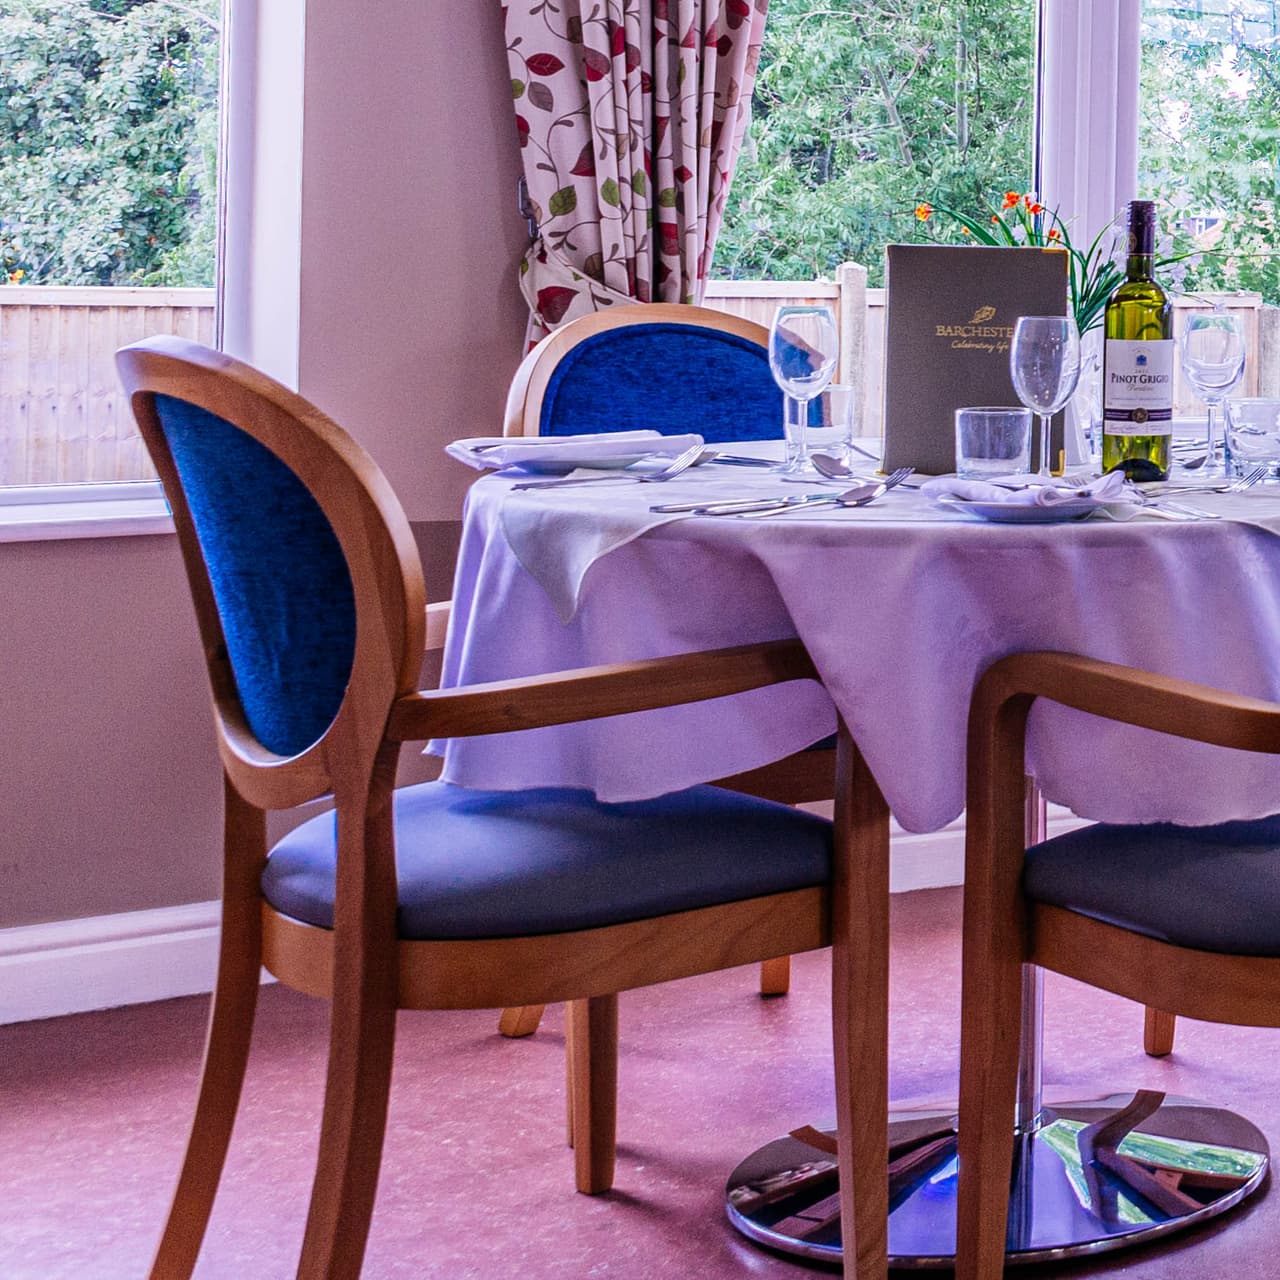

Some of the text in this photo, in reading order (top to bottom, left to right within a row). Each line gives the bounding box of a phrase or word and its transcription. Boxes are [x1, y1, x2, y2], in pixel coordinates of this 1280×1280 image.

[935, 325, 1015, 338] BARCHESTE
[1111, 372, 1169, 385] PINOT GRIGIO
